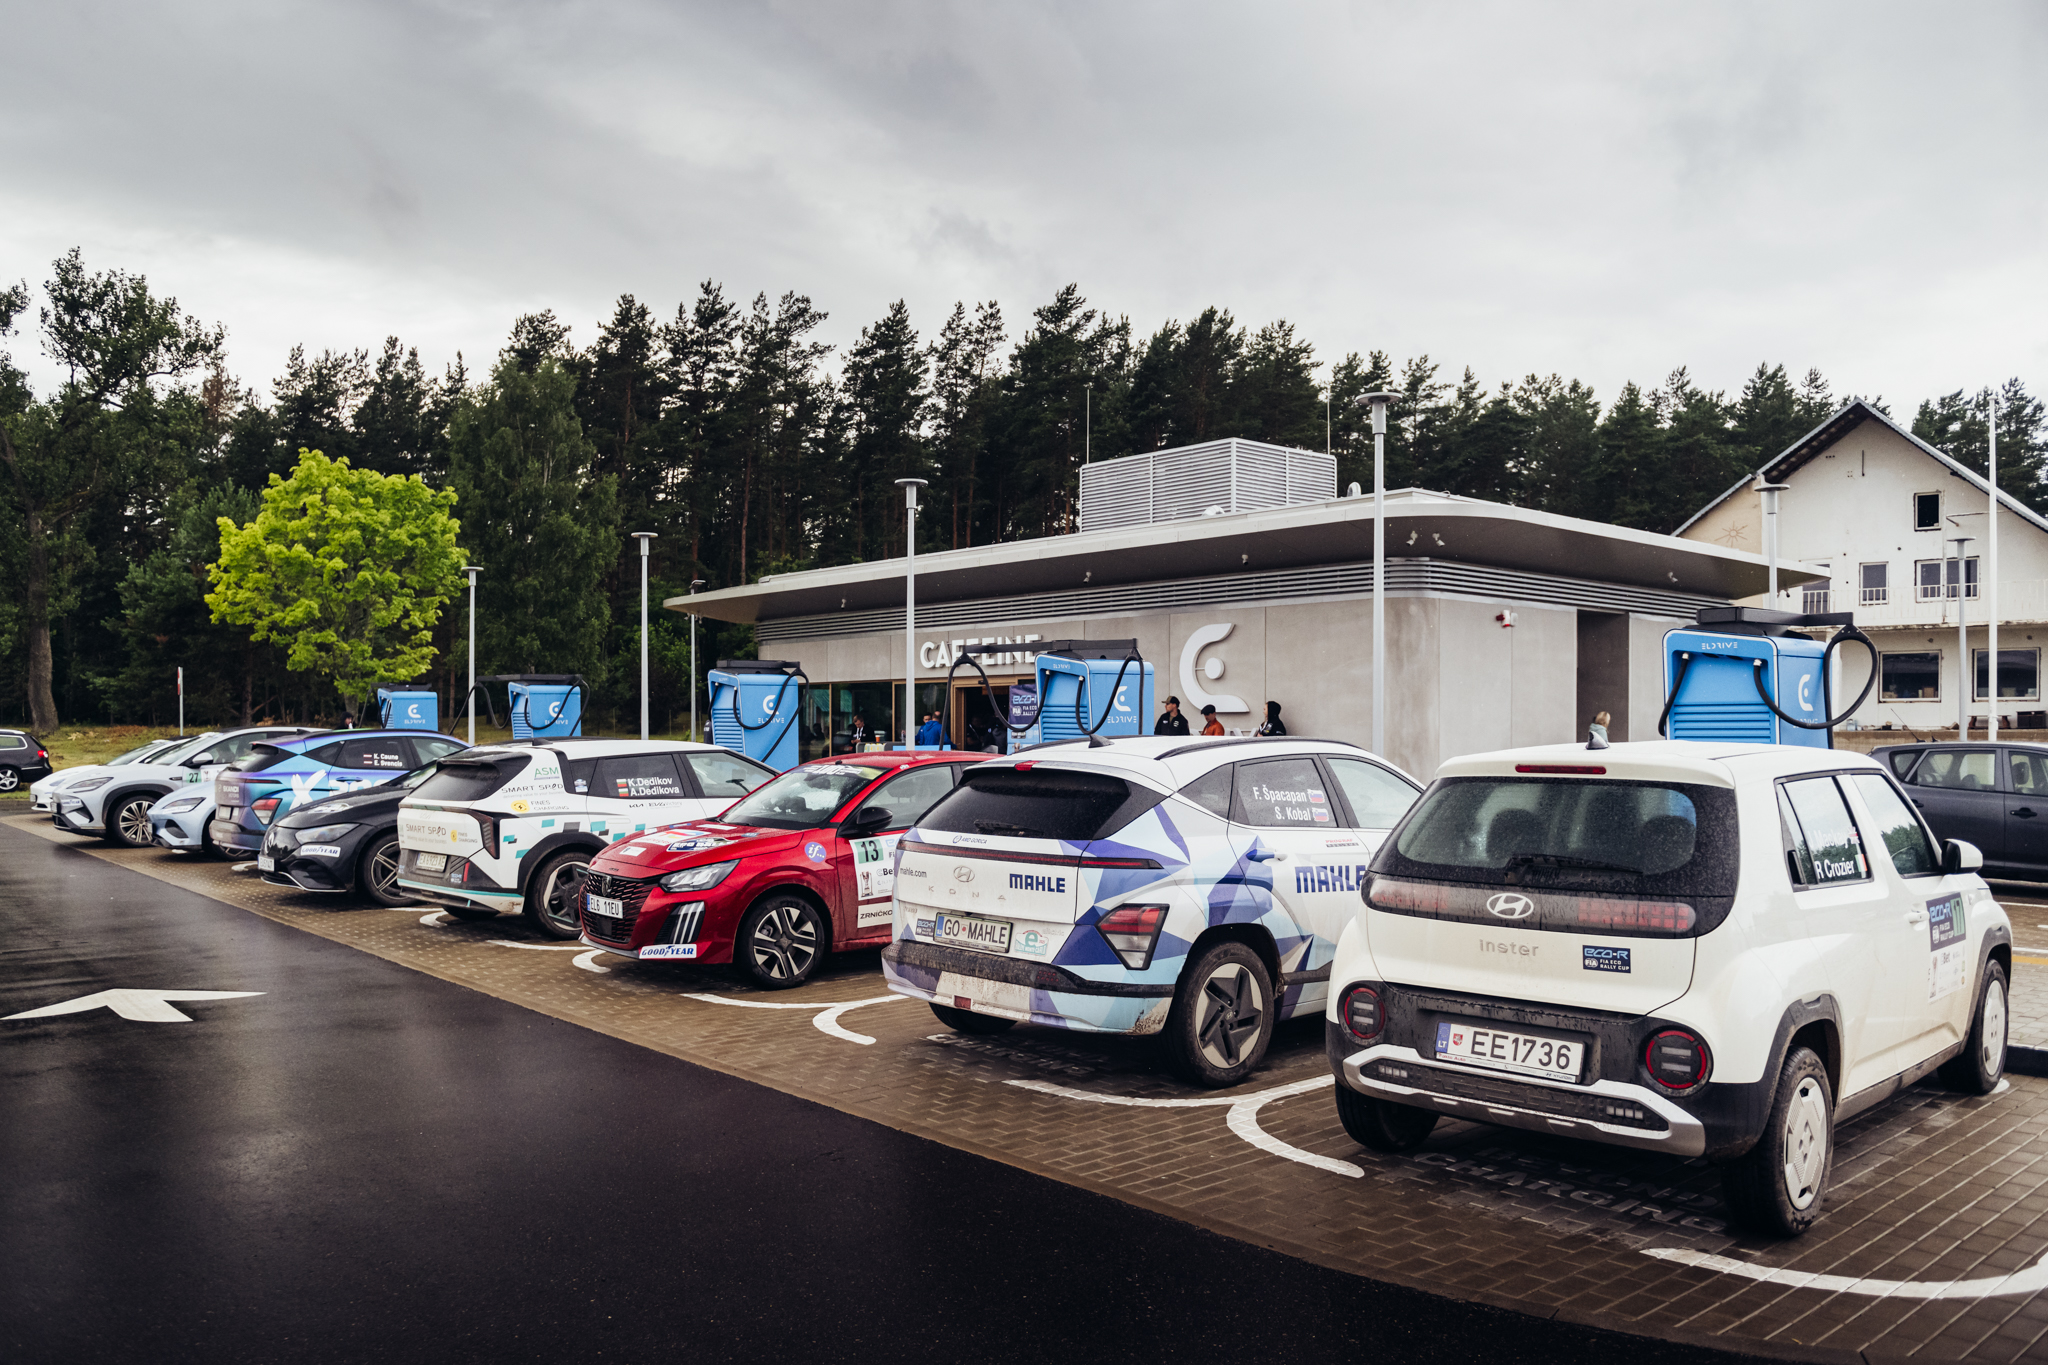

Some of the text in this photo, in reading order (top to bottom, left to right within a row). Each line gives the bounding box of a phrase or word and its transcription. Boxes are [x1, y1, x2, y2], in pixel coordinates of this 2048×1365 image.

[1702, 642, 1738, 650] ELDRIVE
[1012, 694, 1037, 704] eco-
[189, 773, 198, 783] 27
[534, 767, 559, 778] ASM
[628, 777, 672, 787] K.Dedikov
[502, 786, 534, 794] SMART
[630, 786, 680, 796] A.Dedikova
[1252, 784, 1307, 804] F. Špacapan
[1274, 806, 1311, 820] S. Kobal
[406, 824, 426, 834] SMART
[861, 840, 879, 862] 13
[900, 867, 927, 878] mahle.com
[1814, 858, 1854, 879] R Crozier
[1009, 873, 1066, 893] MAHLE
[1295, 865, 1366, 893] MAHLE
[928, 886, 1006, 900] KONA
[944, 919, 1007, 944] GO MAHLE
[1479, 939, 1539, 957] inster
[1470, 1030, 1571, 1070] EE1736
[1413, 1152, 1728, 1232] CHARGING
